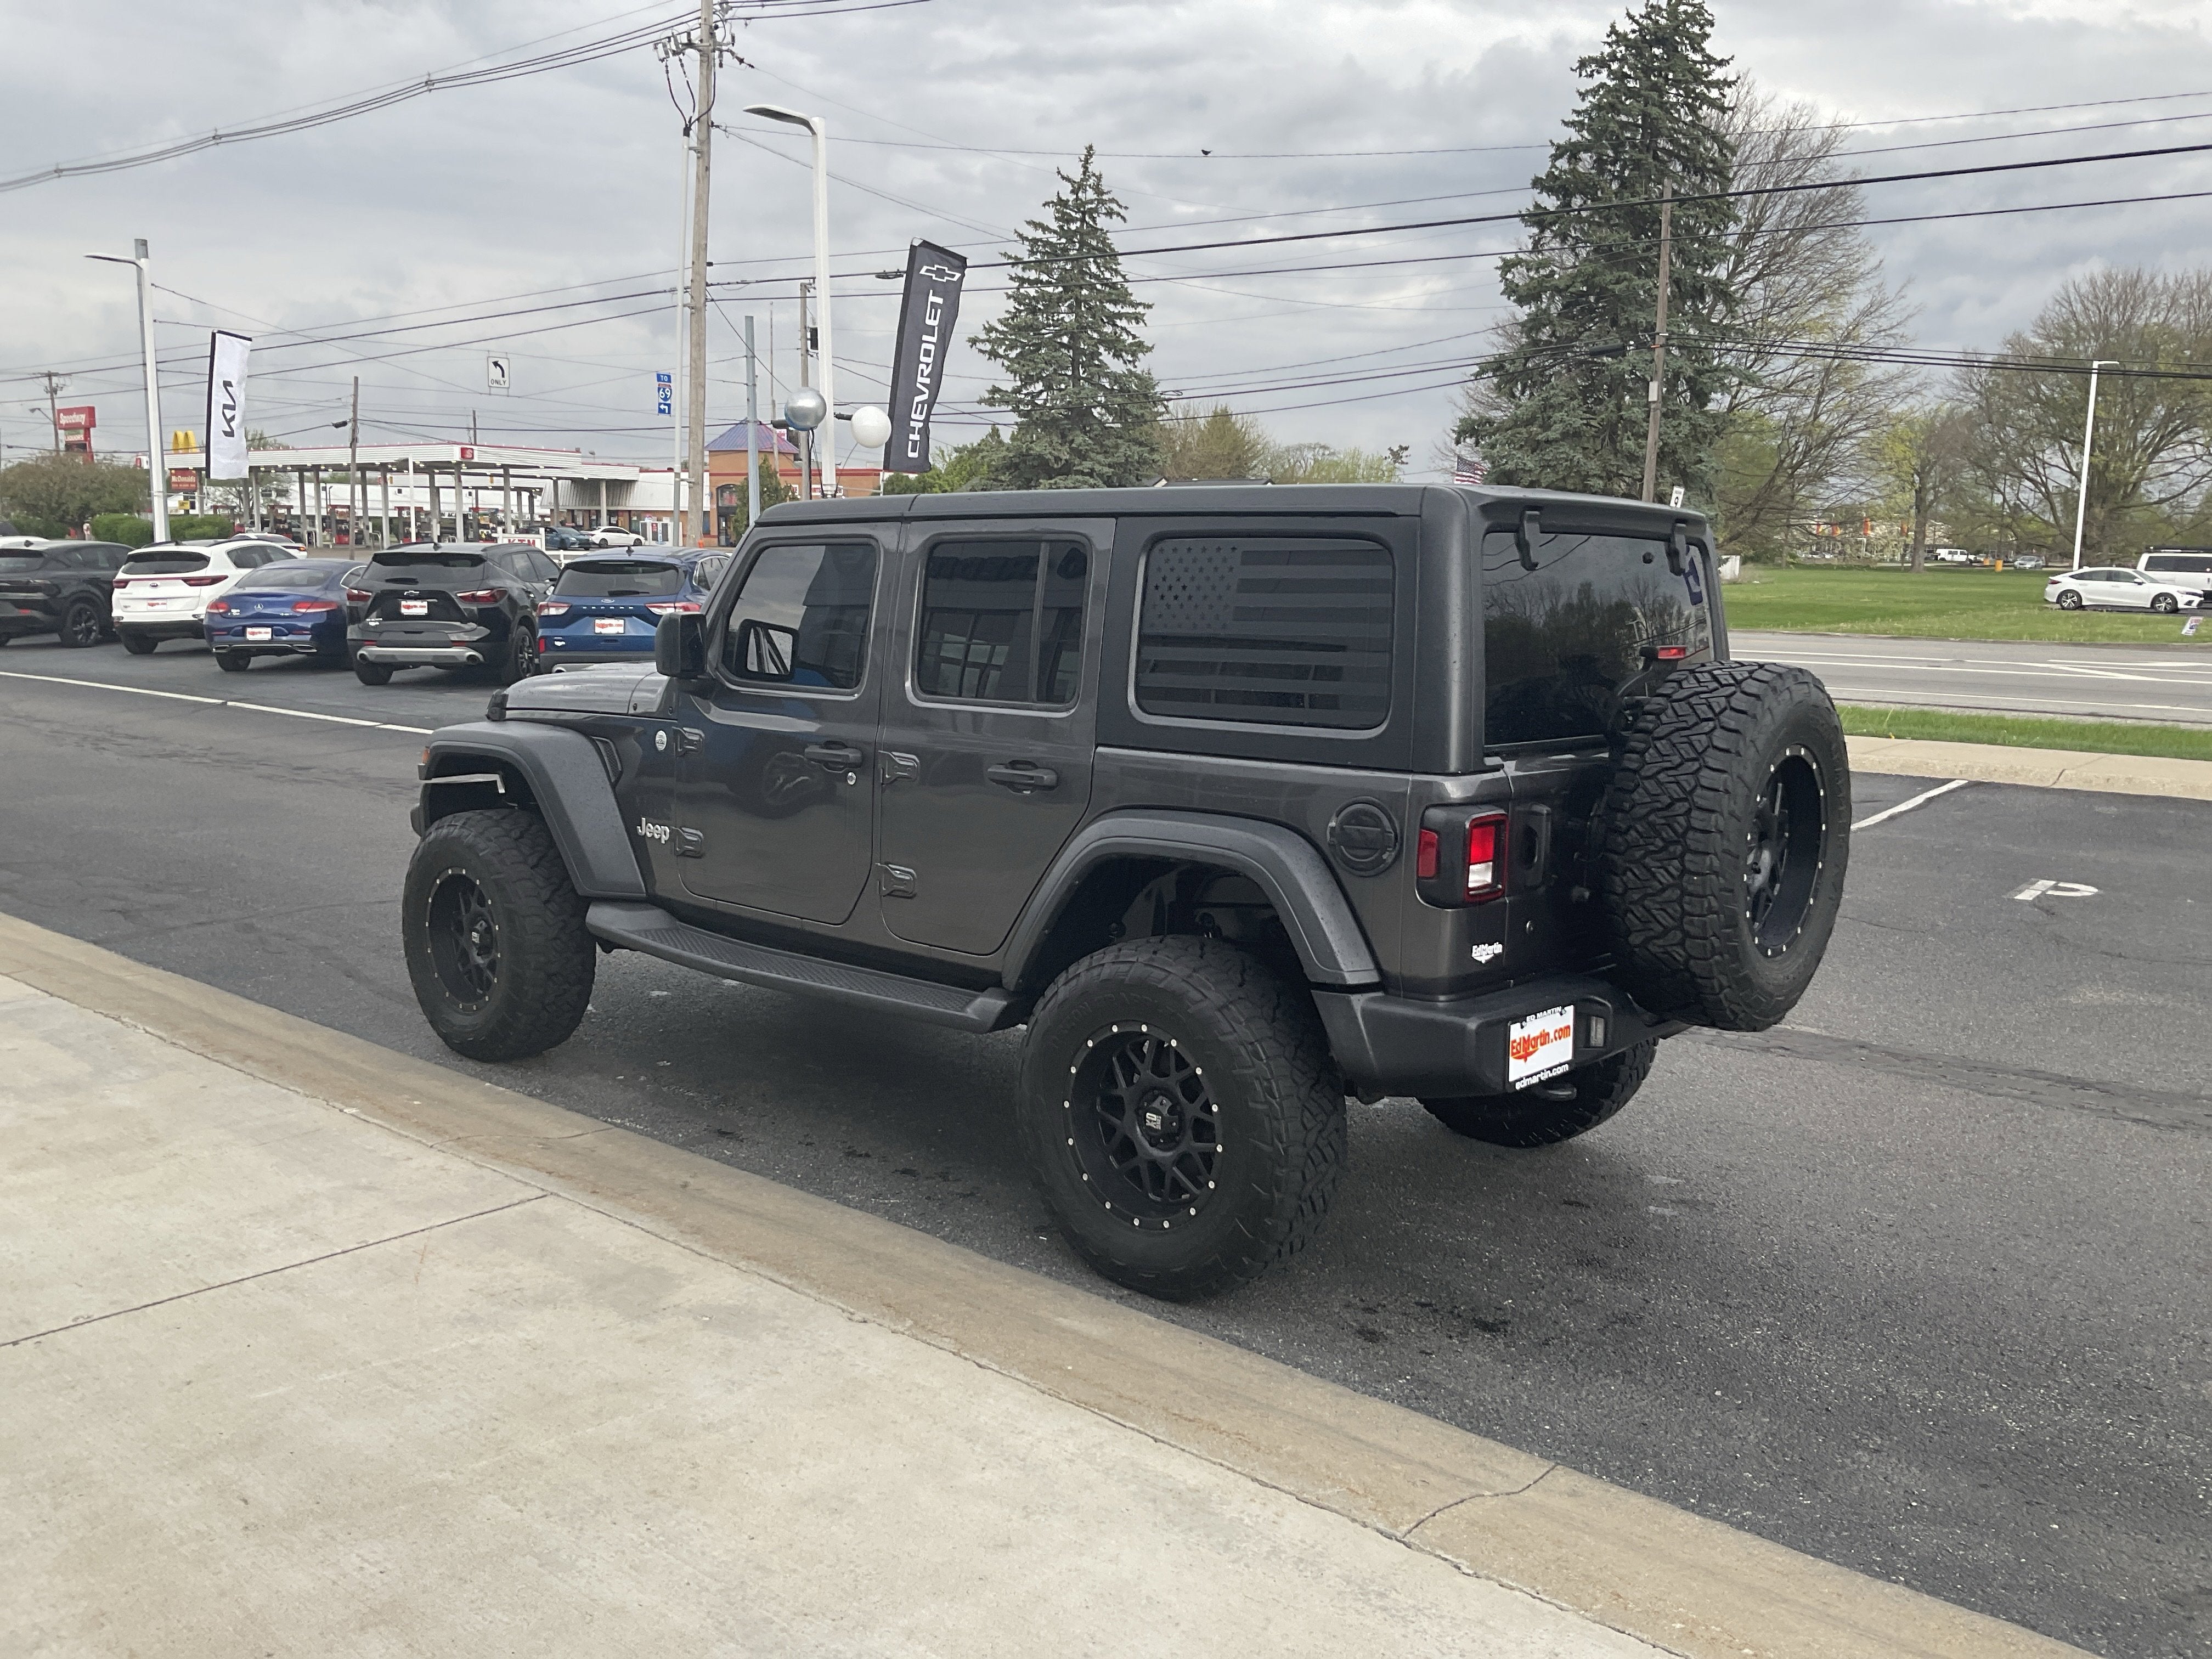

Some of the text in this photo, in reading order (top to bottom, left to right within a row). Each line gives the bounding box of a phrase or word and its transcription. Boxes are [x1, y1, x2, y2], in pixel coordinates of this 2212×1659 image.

[907, 289, 944, 458] CHEVROLET
[659, 388, 671, 399] 69
[59, 412, 86, 425] Speedway
[637, 817, 670, 844] Jeep
[1472, 942, 1503, 957] EdMartin
[1537, 1006, 1562, 1019] MARTIN
[1510, 1025, 1571, 1056] EdMartin.com
[1515, 1063, 1569, 1090] edmartin.com
